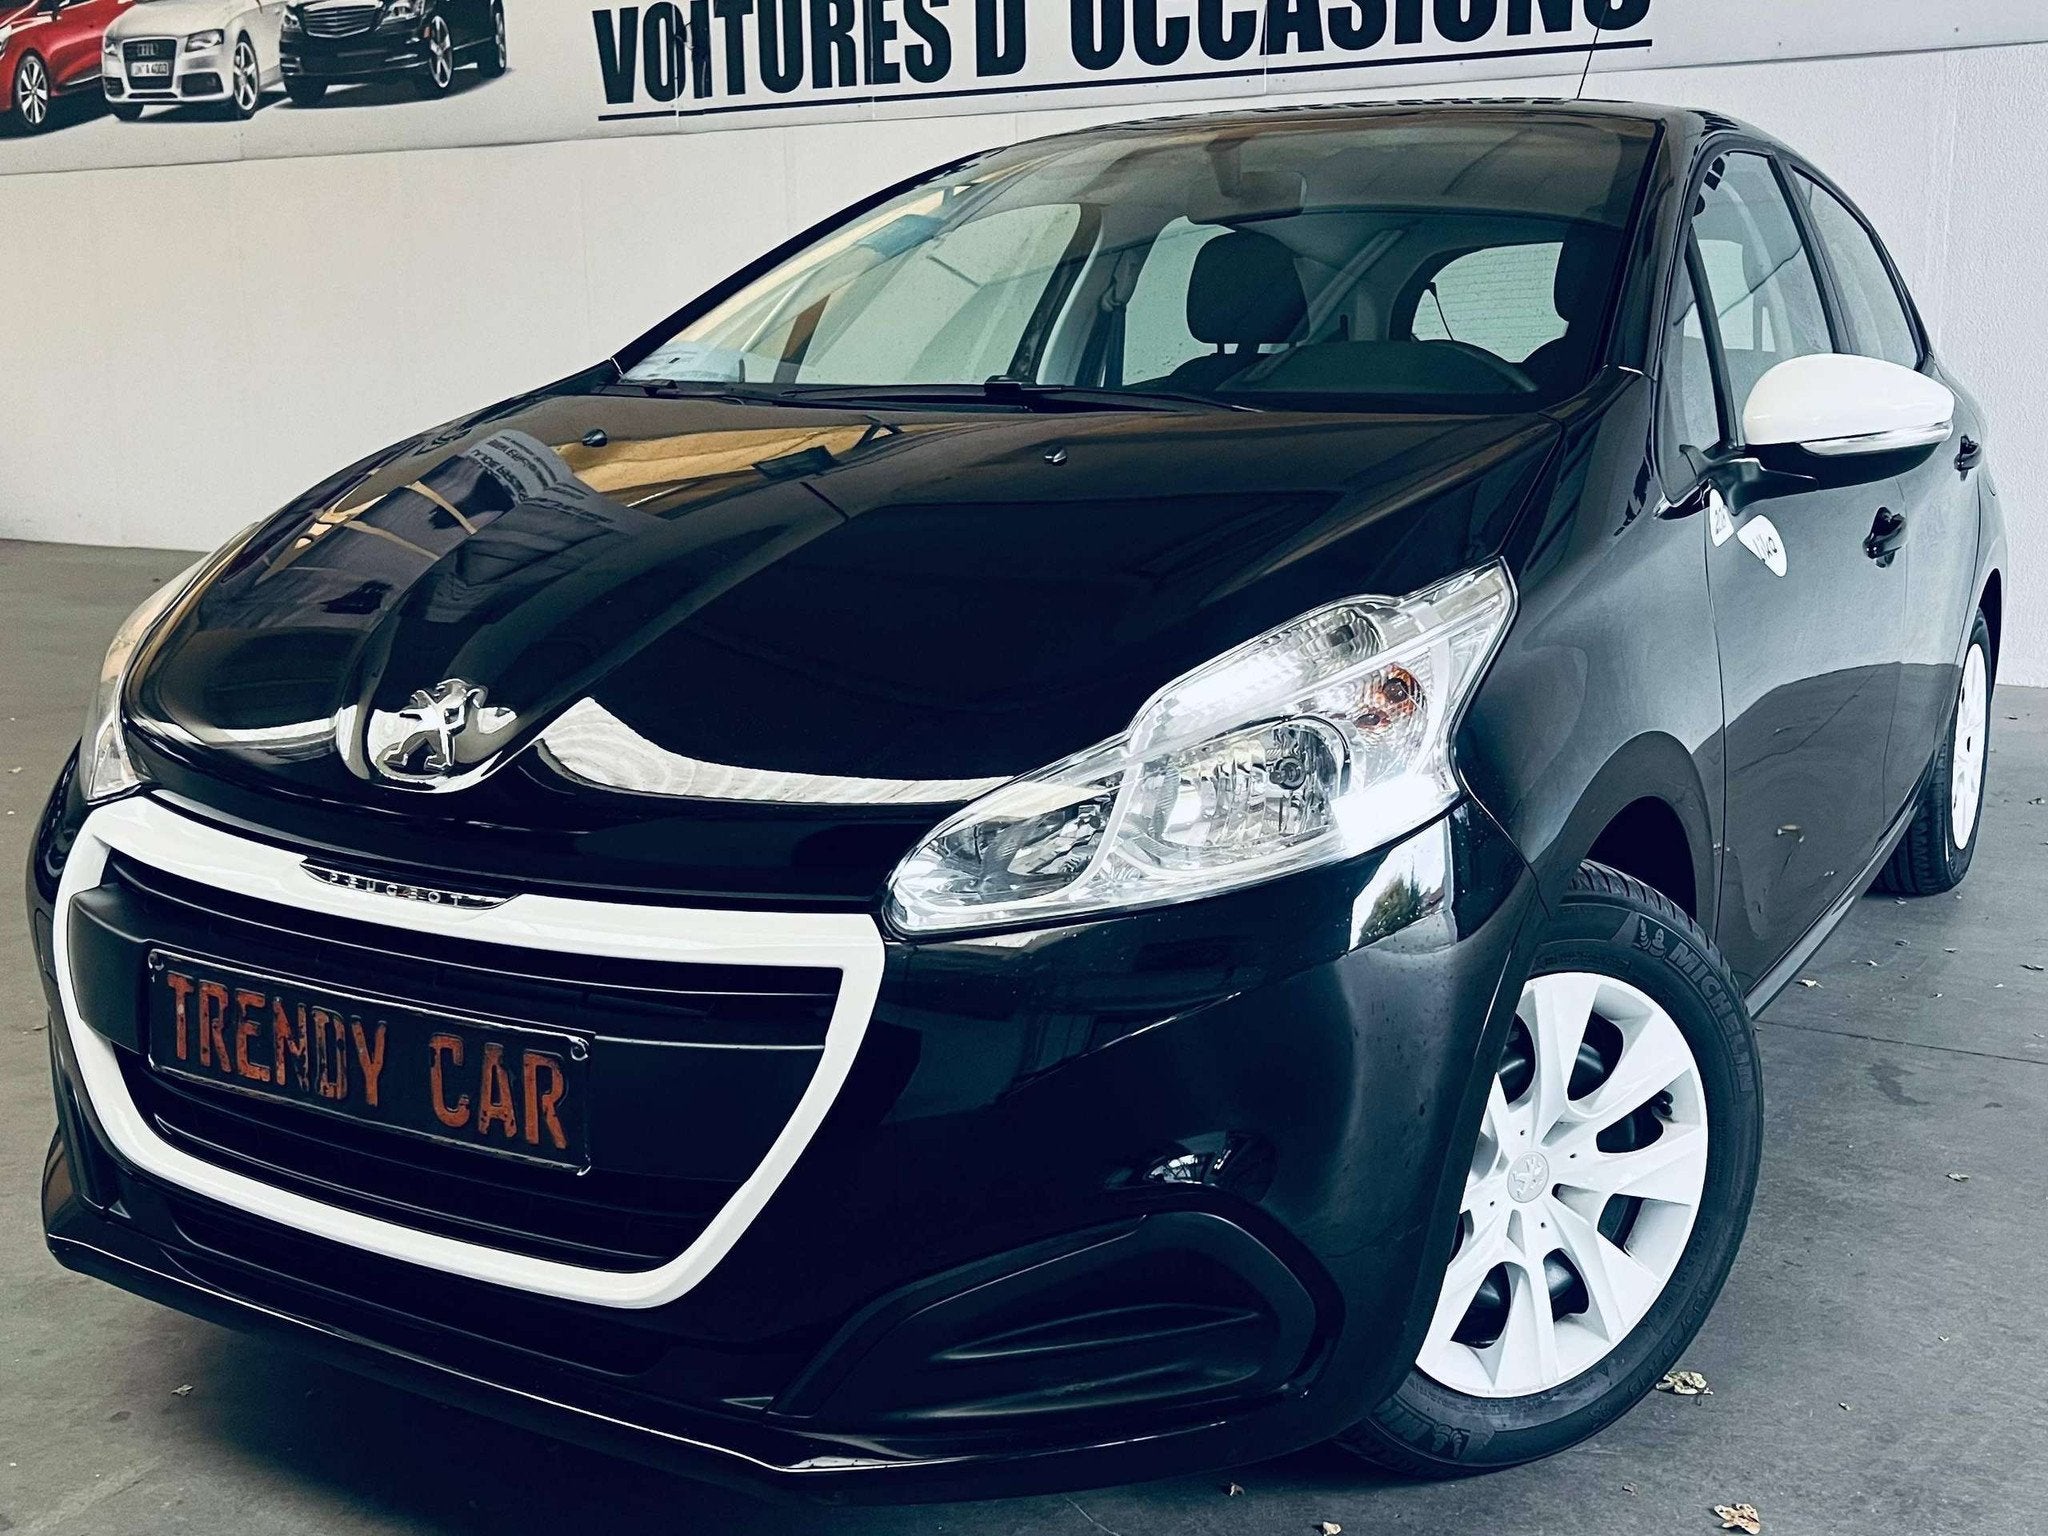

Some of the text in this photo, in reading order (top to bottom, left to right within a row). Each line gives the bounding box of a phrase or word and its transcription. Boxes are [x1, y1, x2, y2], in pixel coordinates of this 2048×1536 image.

[592, 0, 952, 105] VOITURES
[166, 970, 568, 1150] TRENDY CAR
